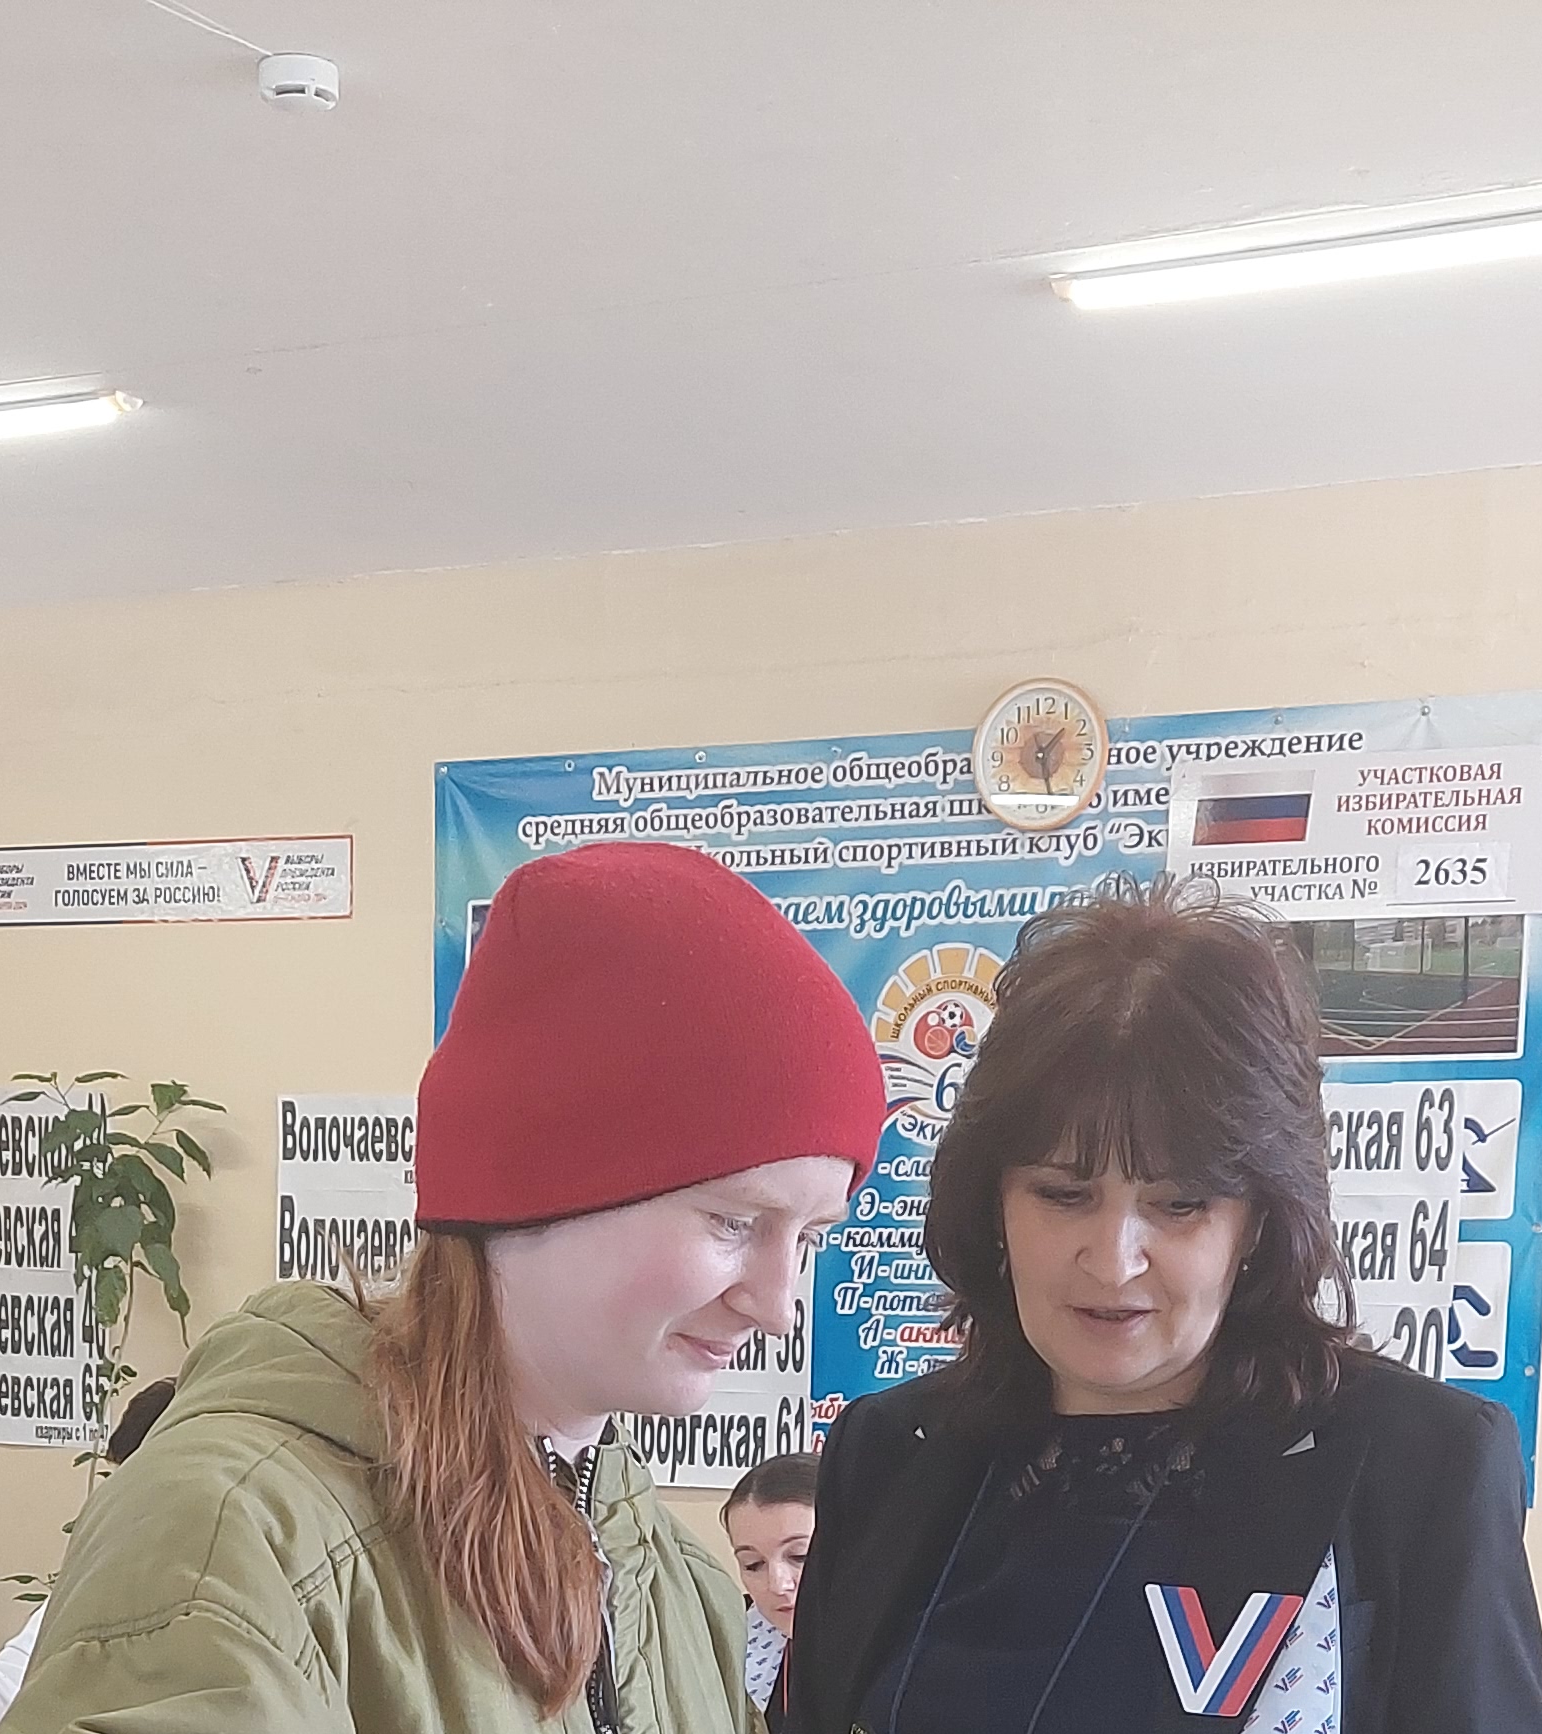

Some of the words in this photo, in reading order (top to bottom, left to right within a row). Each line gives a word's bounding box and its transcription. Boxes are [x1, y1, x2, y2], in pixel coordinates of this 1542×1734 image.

[1017, 706, 1031, 724] 11
[1036, 697, 1056, 715] 12
[1064, 702, 1069, 721] 1
[1000, 726, 1019, 746] 10
[1076, 719, 1087, 737] 2
[595, 762, 825, 803] Муниципальное
[1165, 731, 1364, 770] учреждение
[991, 751, 1004, 769] 9
[998, 774, 1011, 792] 8
[1072, 769, 1086, 787] 4
[1357, 762, 1503, 787] УЧАСТКОВАЯ
[1335, 786, 1524, 814] ИЗБИРАТЕЛЬНАЯ
[520, 815, 626, 844] средняя
[634, 800, 939, 838] общеобразовательная
[1366, 814, 1488, 837] КОМИССИЯ
[695, 838, 829, 871] кольный
[838, 832, 1019, 872] спортивный
[1026, 825, 1100, 862] клуб
[65, 861, 124, 882] ВМЕСТЕ
[124, 860, 154, 880] МЫ
[155, 858, 195, 879] СИЛА
[1190, 855, 1380, 879] ИЗБИРАТЕЛЬНОГО
[1413, 856, 1489, 888] 2635
[53, 885, 130, 908] ГОЛОСУЕМ
[131, 886, 152, 906] ЗА
[152, 883, 222, 906] РОССИЮ!
[1250, 881, 1345, 903] УЧАСТКА
[1350, 874, 1379, 898] №
[854, 884, 1037, 934] здоровыми
[890, 984, 935, 1041] ШКОЛЬНЫЙ
[281, 1100, 415, 1163] Волочаевс
[1415, 1087, 1456, 1172] 63
[1409, 1199, 1450, 1283] 64
[777, 1395, 806, 1456] 61
